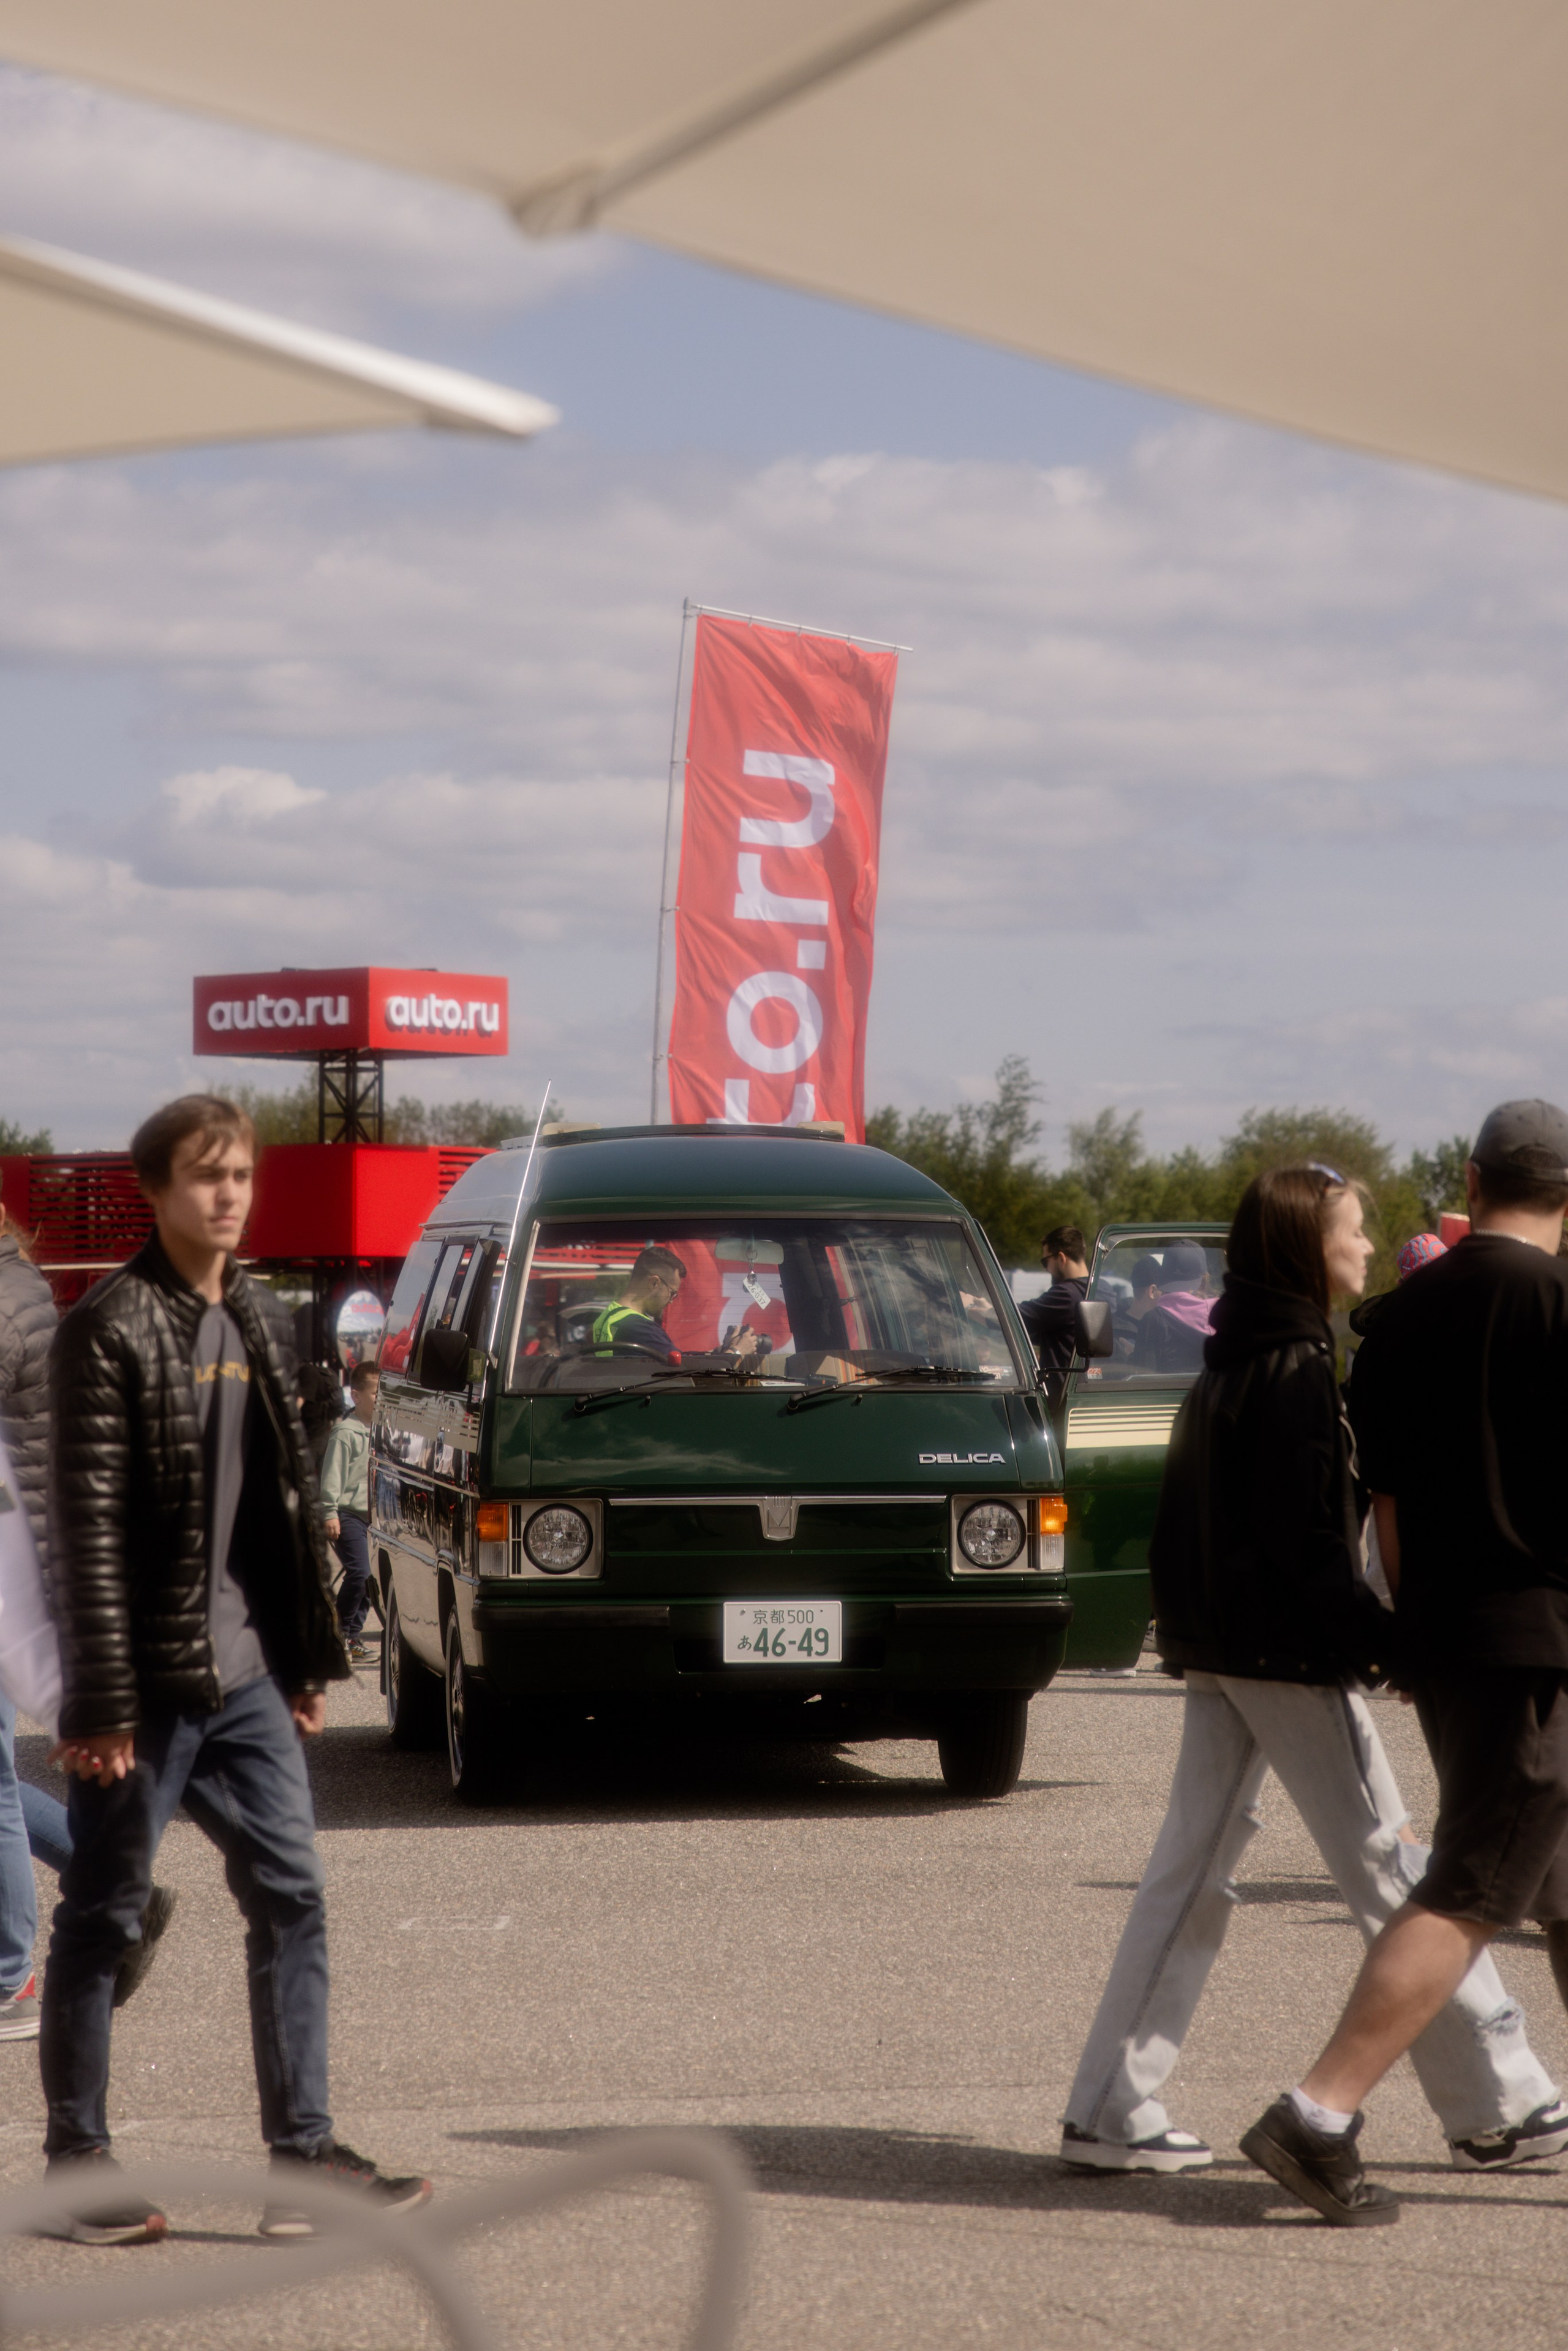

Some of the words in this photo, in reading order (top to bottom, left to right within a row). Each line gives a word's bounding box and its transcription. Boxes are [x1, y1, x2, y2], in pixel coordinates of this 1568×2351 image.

[208, 995, 349, 1031] auto.ru
[390, 994, 499, 1032] auto.ru
[919, 1453, 1006, 1464] DELICA
[753, 1609, 785, 1625] 京都
[787, 1609, 814, 1624] 500
[737, 1635, 752, 1651] あ
[753, 1627, 829, 1658] 46-49
